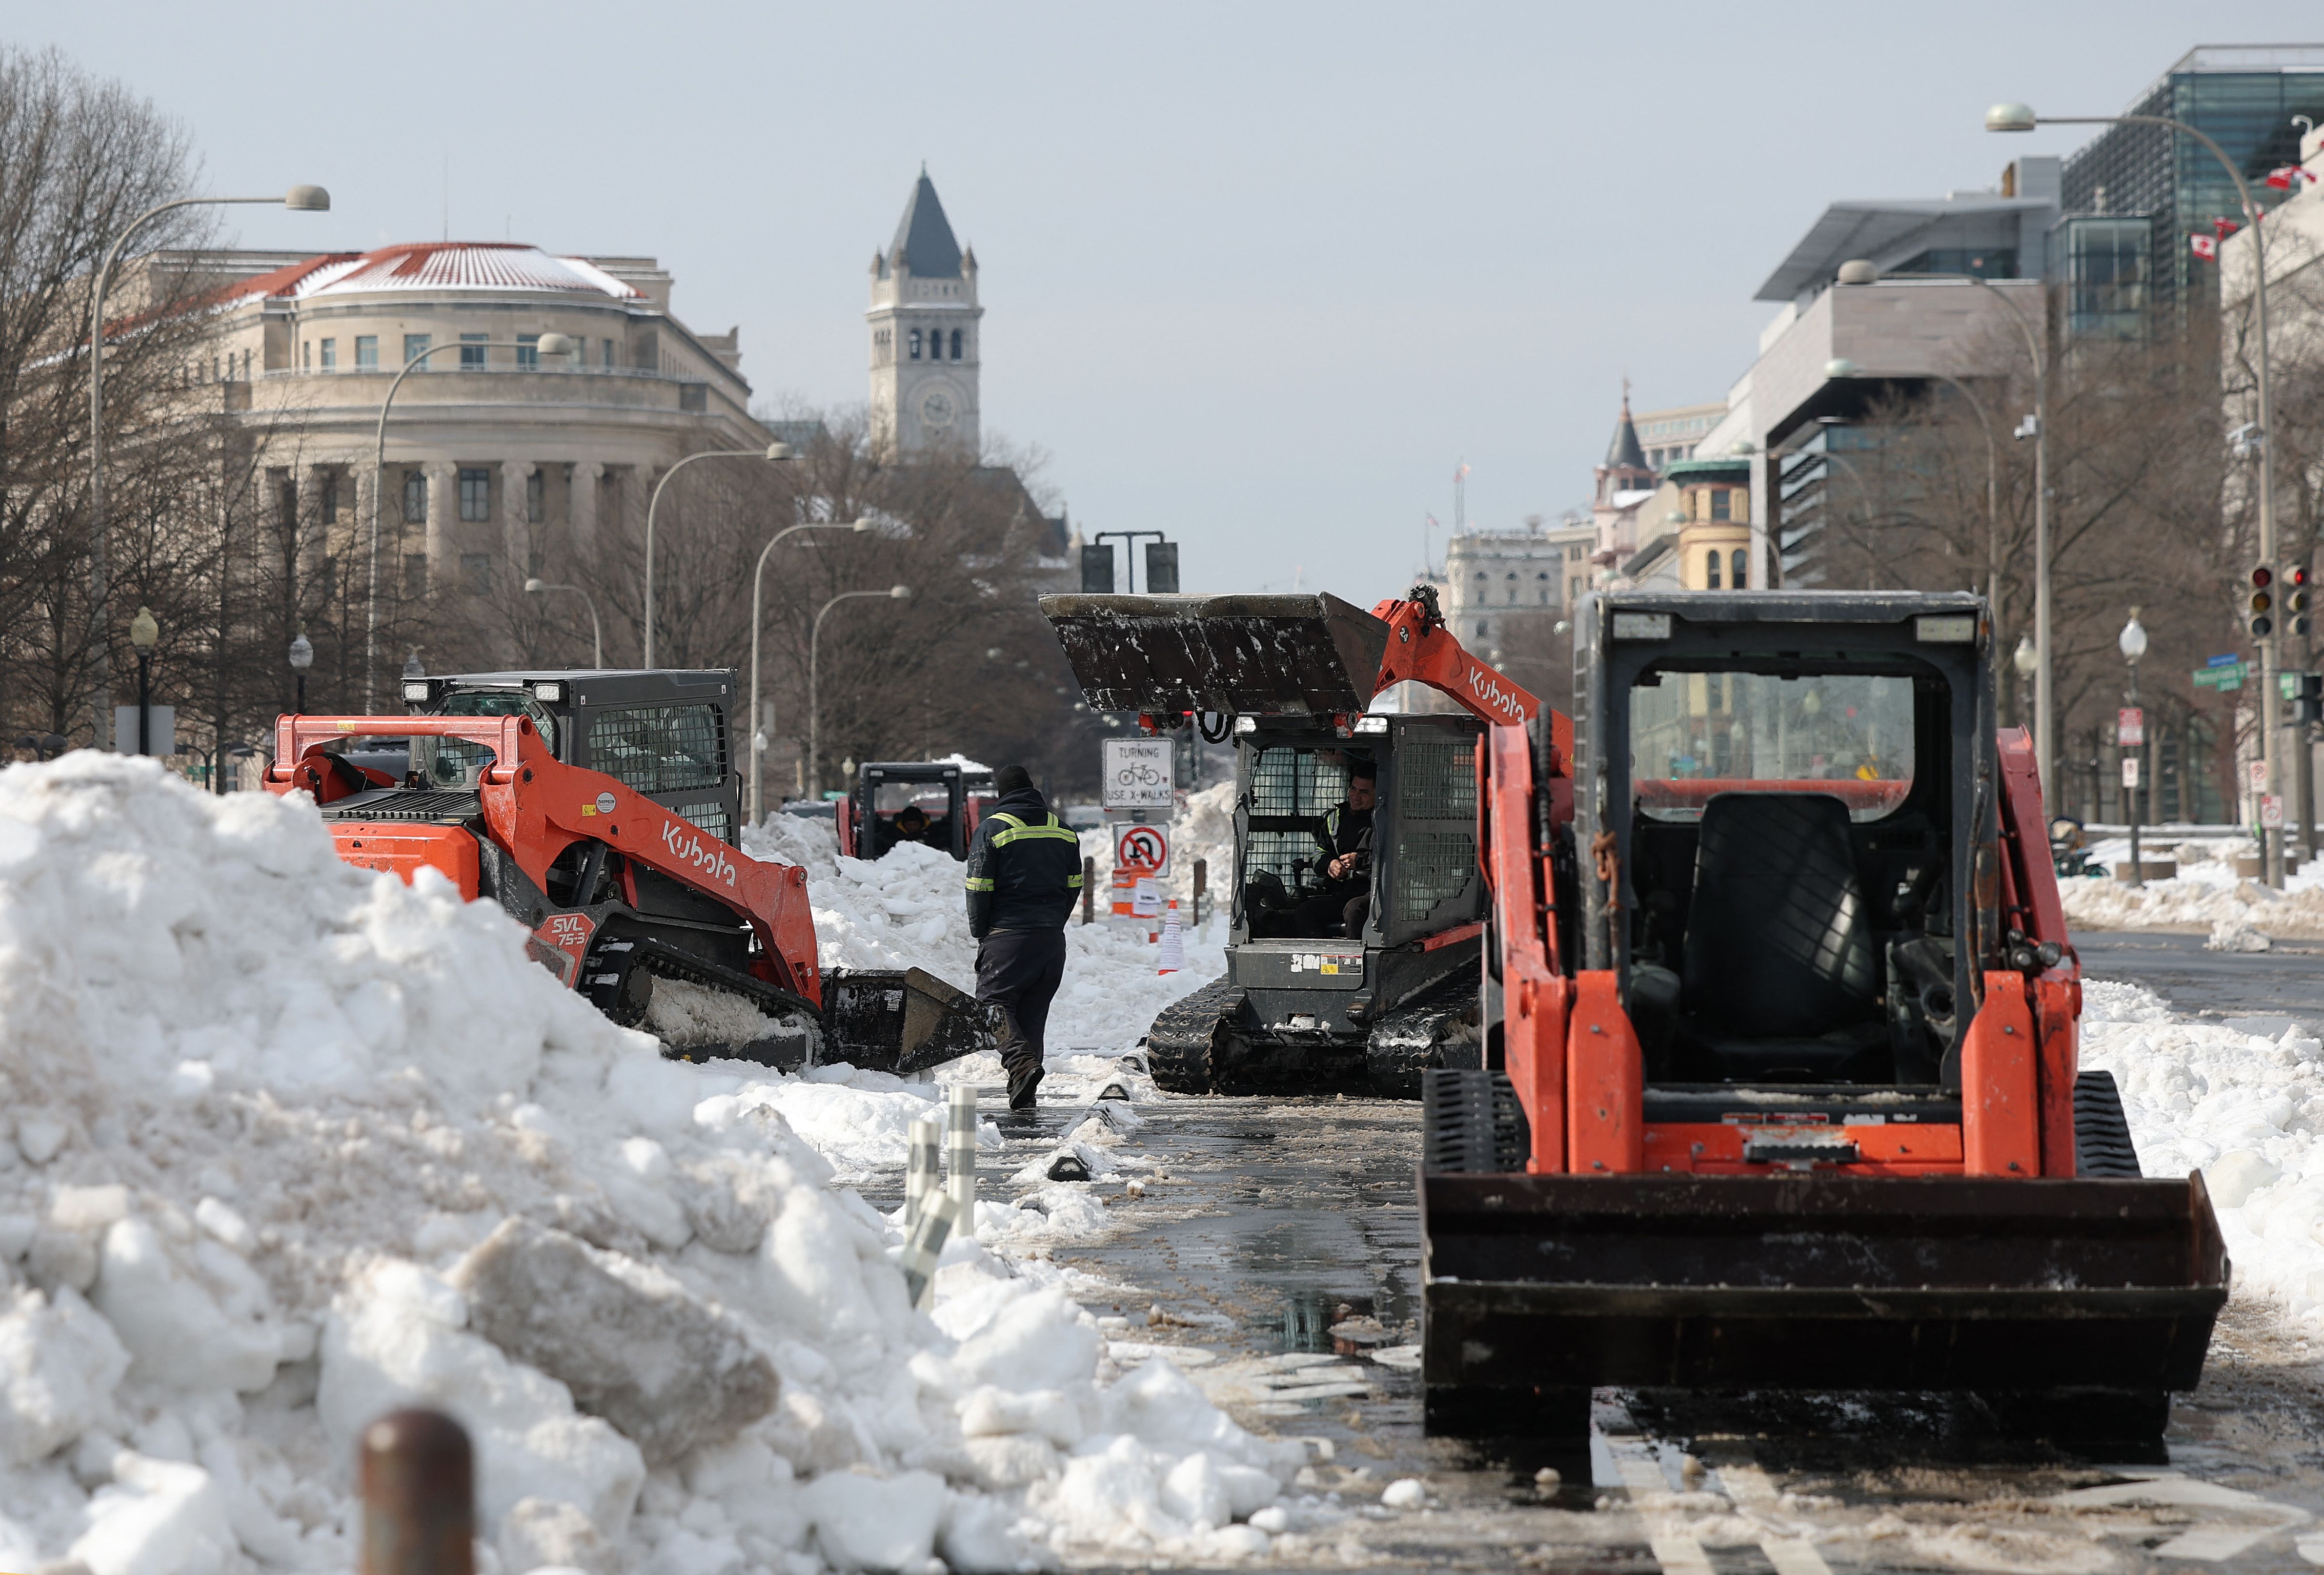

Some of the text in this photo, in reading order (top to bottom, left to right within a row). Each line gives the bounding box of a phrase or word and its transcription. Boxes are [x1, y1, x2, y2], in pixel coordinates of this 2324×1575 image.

[1400, 627, 1408, 642] 24
[1469, 666, 1524, 722] Kubota
[1119, 747, 1159, 758] TURNING
[1107, 790, 1171, 800] USE X-WALKS
[662, 820, 736, 887] Kubota
[552, 917, 583, 933] SVL
[558, 932, 585, 946] 75-3
